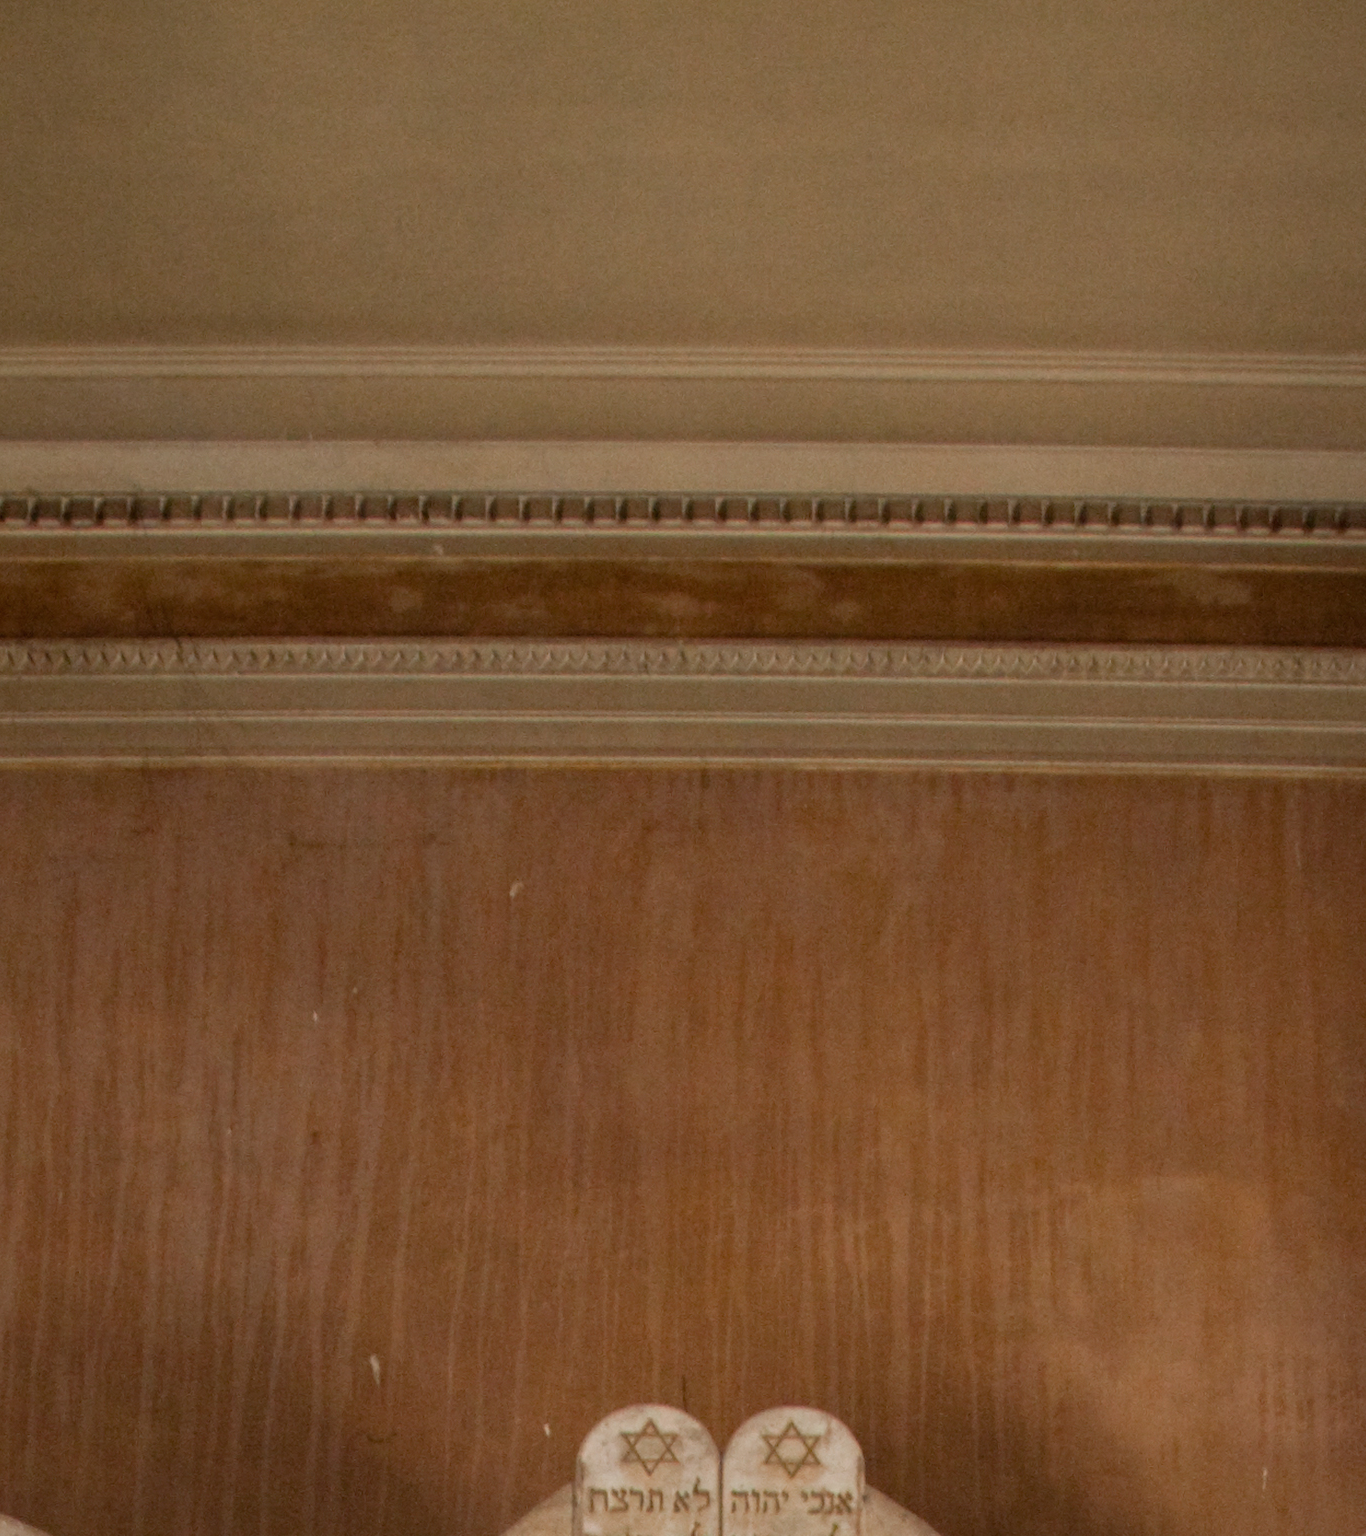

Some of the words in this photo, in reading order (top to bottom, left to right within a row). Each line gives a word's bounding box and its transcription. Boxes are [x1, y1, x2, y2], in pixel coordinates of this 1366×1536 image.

[589, 1487, 664, 1514] תרצח
[673, 1476, 710, 1513] לא
[730, 1488, 789, 1514] יהוה
[801, 1489, 853, 1515] אנכי
